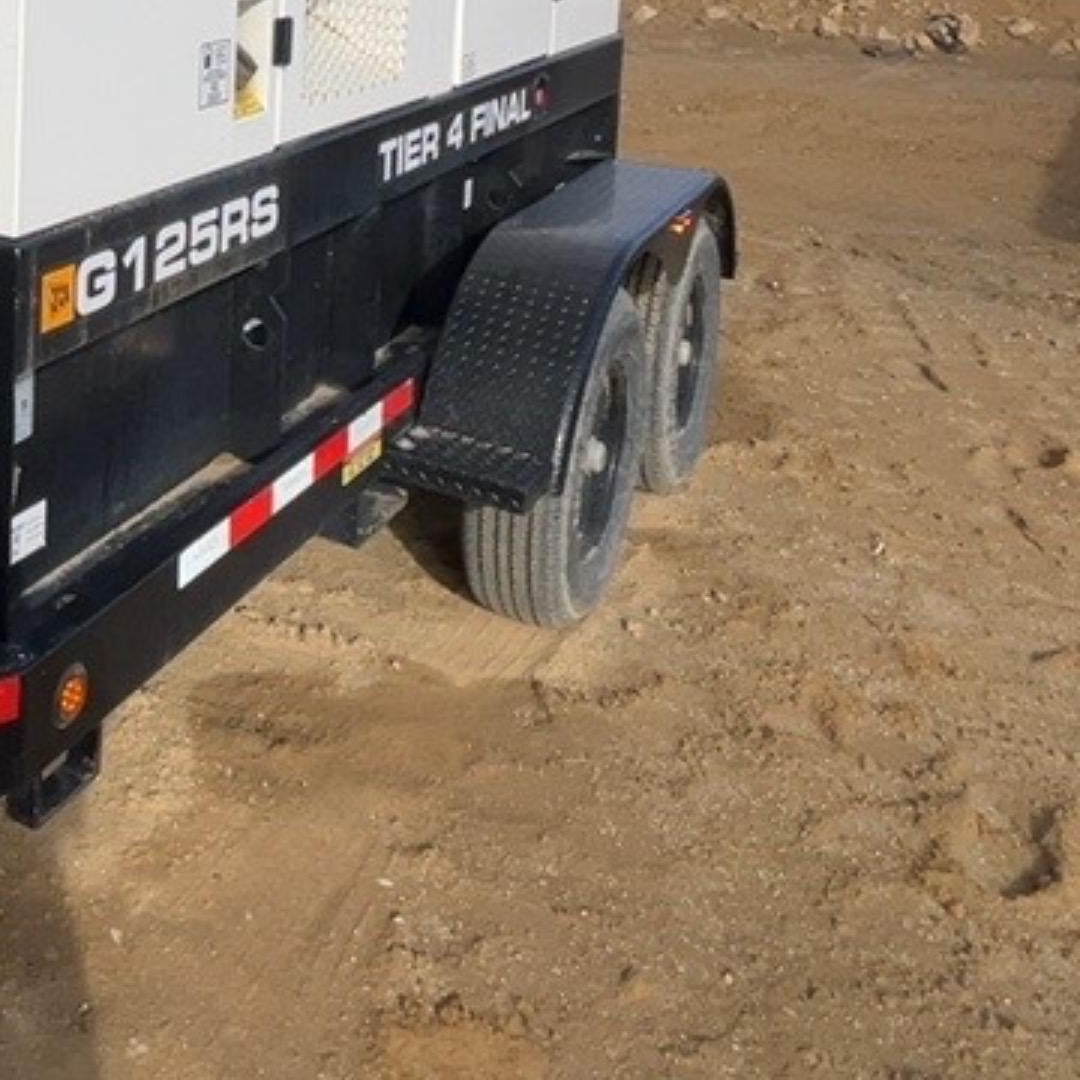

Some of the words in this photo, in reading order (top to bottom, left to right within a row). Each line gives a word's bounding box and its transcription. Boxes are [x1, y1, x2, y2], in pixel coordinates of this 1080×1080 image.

[378, 122, 440, 182] TIER
[446, 112, 464, 151] 4
[470, 88, 532, 143] FINAL
[77, 184, 280, 317] G125RS
